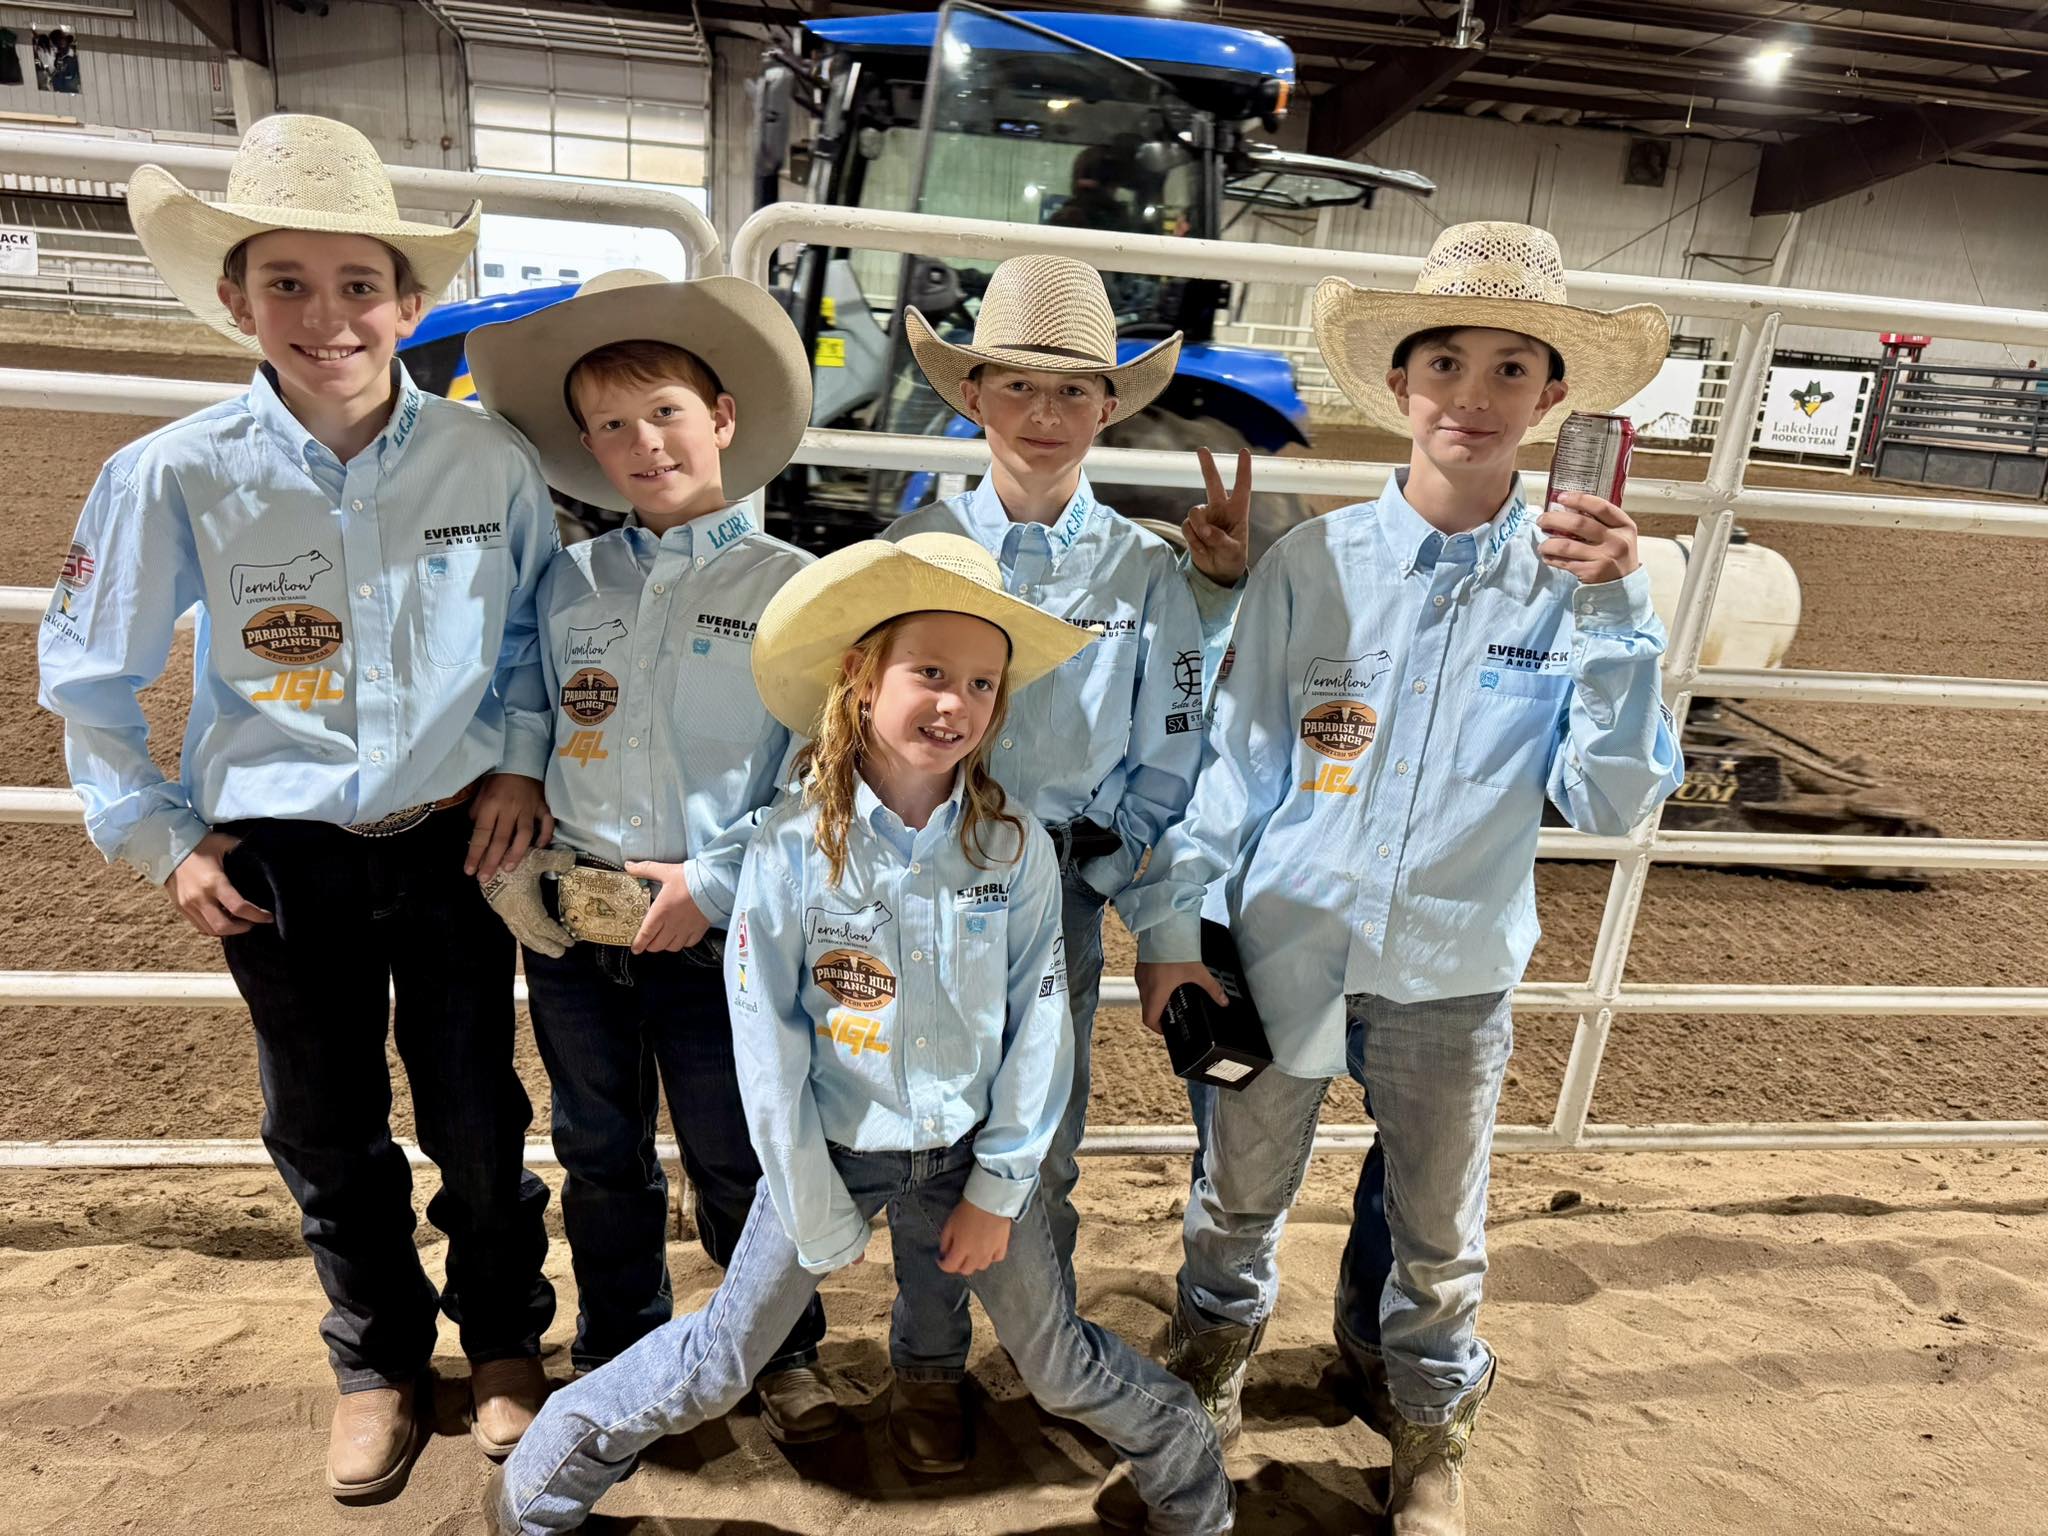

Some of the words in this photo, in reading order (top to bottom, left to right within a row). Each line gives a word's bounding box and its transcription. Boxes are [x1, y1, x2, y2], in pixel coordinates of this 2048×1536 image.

[1773, 421, 1839, 437] Lakeland
[1771, 433, 1806, 443] RODEO
[1808, 436, 1836, 446] TEAM
[424, 522, 501, 540] EVERBLACK
[445, 535, 488, 546] ANGUS
[246, 626, 307, 645] PARADISE
[310, 625, 340, 640] HILL
[270, 637, 321, 650] RANCH
[1487, 643, 1569, 662] EVERBLACK
[1505, 658, 1551, 670] ANGUS
[600, 690, 617, 703] HILL
[576, 700, 605, 710] RANCH
[1303, 721, 1355, 735] PARADISE
[1358, 724, 1375, 739] HILL
[1322, 733, 1363, 746] RANCH
[816, 967, 866, 984] PARADISE
[869, 975, 894, 994] HILL
[836, 980, 877, 997] RANCH
